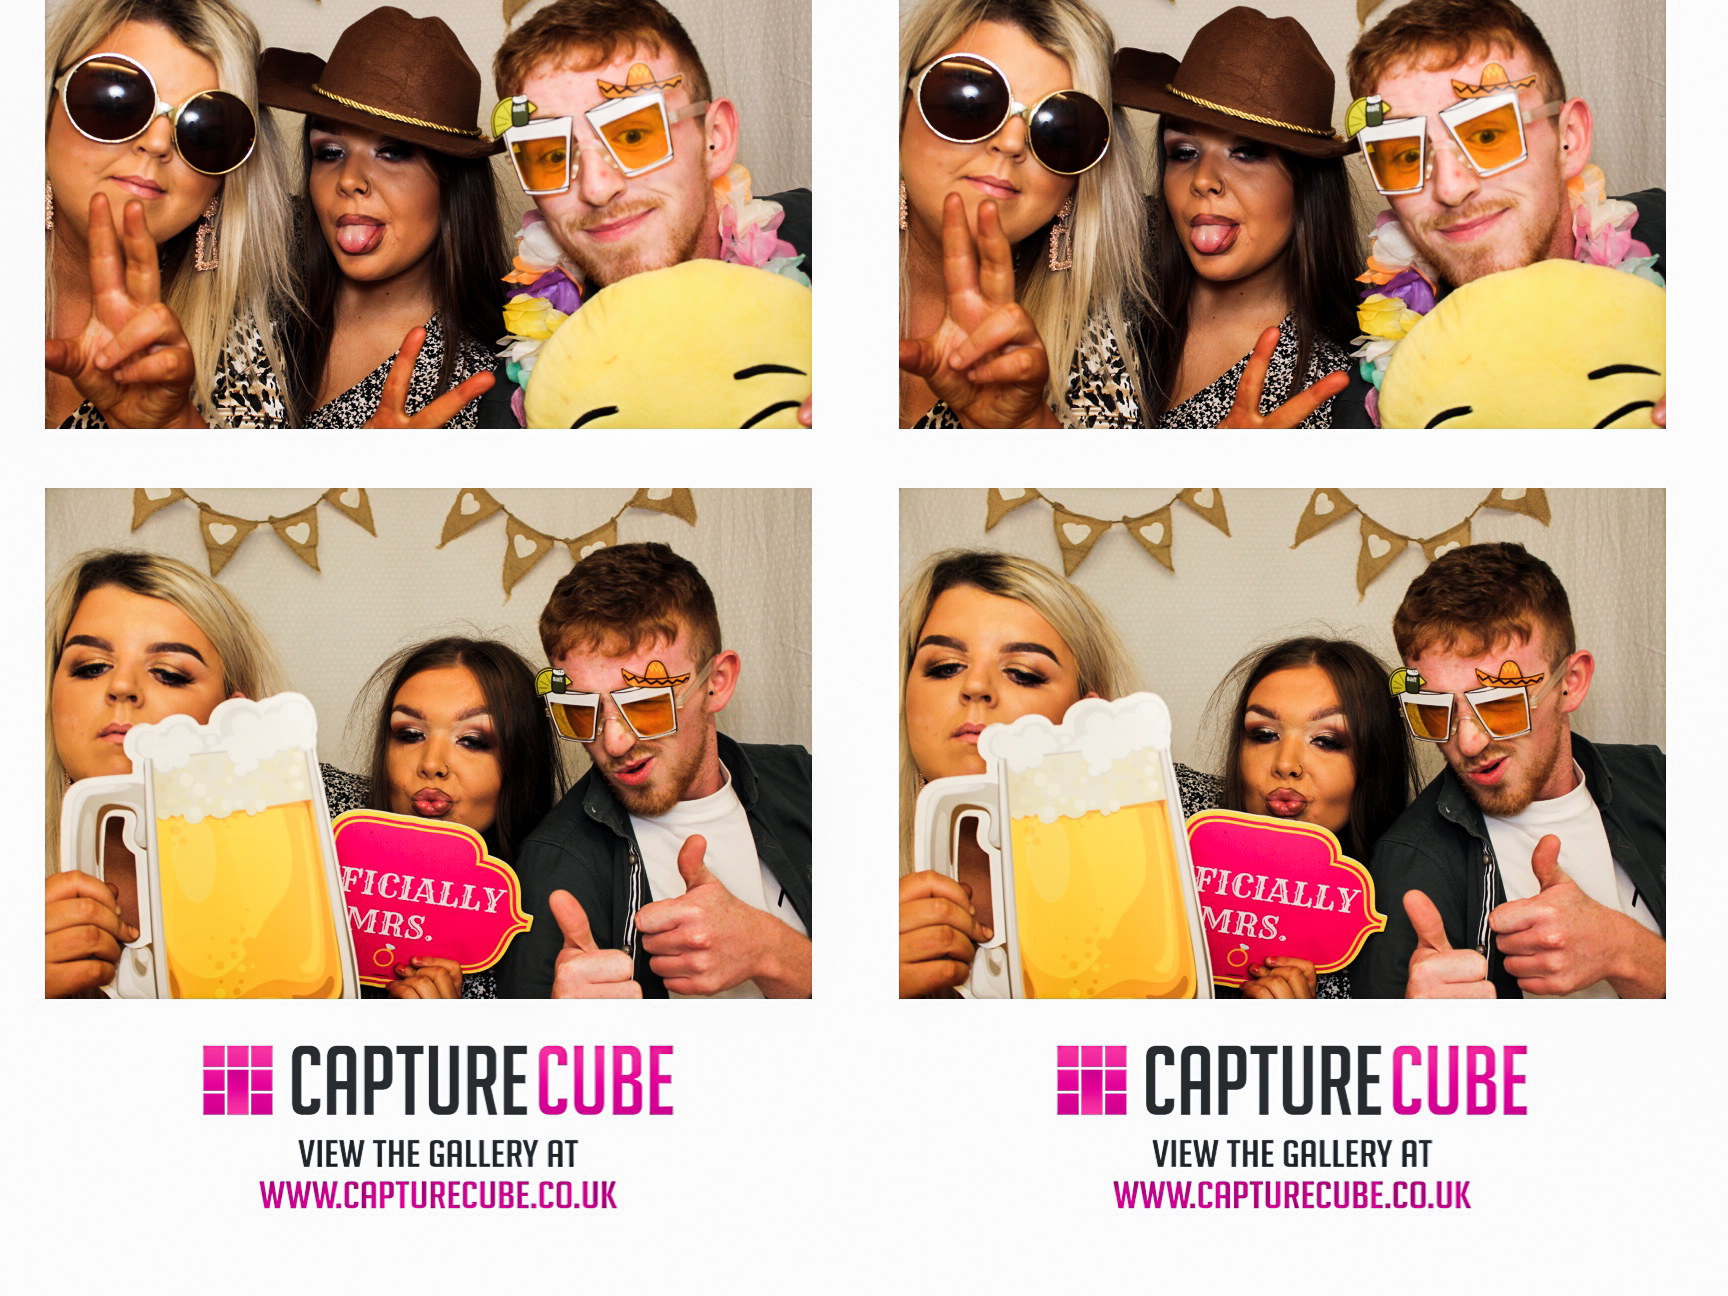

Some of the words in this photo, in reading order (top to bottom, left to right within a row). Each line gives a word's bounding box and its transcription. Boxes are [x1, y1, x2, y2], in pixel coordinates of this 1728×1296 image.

[339, 865, 508, 914] FICIALLY
[1193, 865, 1362, 914] FICIALLY
[348, 906, 433, 942] MRS.
[1202, 906, 1287, 942] MRS.
